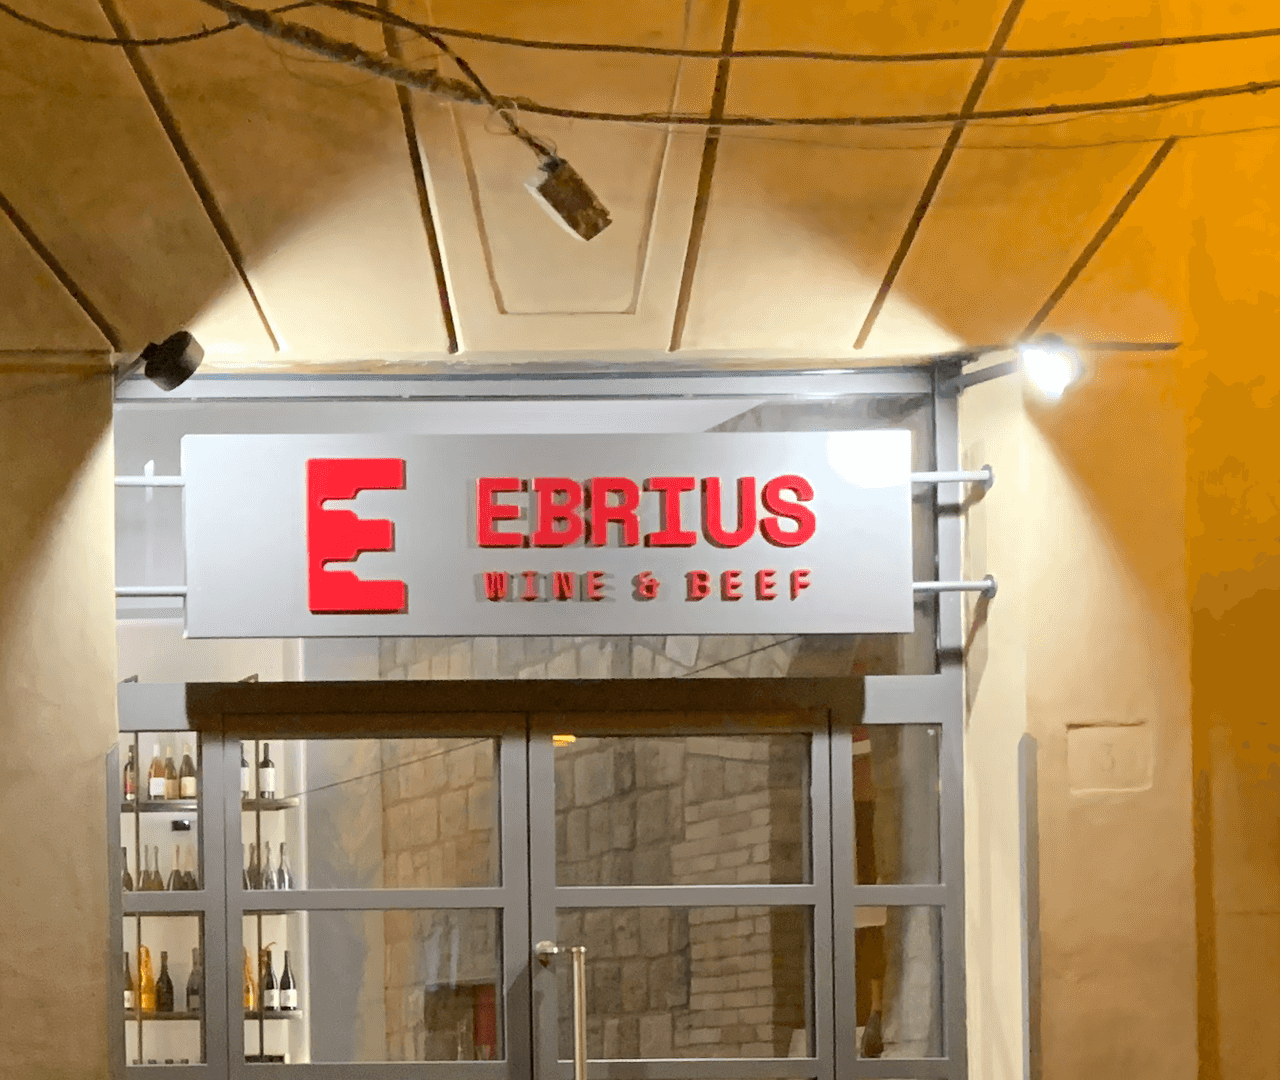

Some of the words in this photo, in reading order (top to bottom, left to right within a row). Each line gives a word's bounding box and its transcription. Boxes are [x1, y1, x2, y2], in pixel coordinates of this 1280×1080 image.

[476, 474, 817, 549] EBRIUS
[481, 570, 606, 601] WINE
[636, 570, 662, 599] &
[688, 570, 814, 601] BEEF
